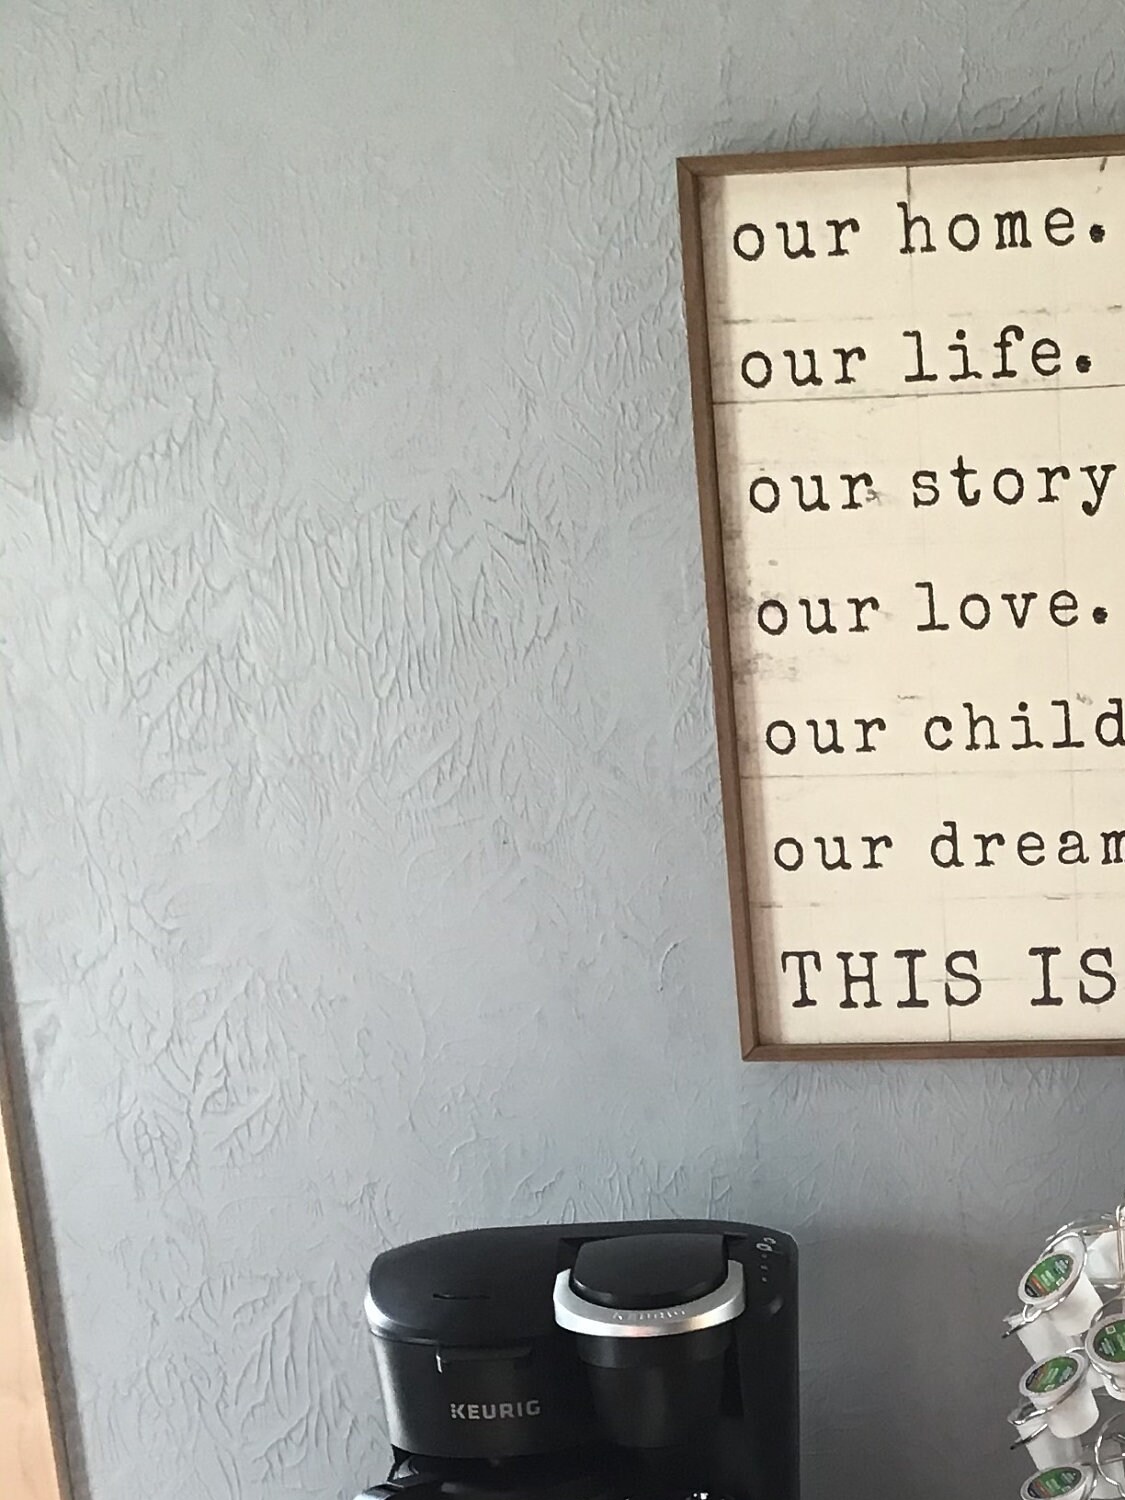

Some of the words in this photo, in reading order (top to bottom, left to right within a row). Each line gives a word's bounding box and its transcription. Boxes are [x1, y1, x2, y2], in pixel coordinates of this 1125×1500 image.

[733, 218, 860, 262] our
[896, 201, 1106, 255] home.
[741, 346, 866, 389] our
[902, 324, 1092, 383] life.
[749, 471, 873, 514] our
[757, 596, 880, 636] our
[915, 581, 1108, 632] love.
[765, 717, 887, 756] our
[774, 835, 893, 872] our
[781, 949, 982, 1009] THIS
[1028, 946, 1117, 1007] IS
[450, 1400, 541, 1420] KEURIG
